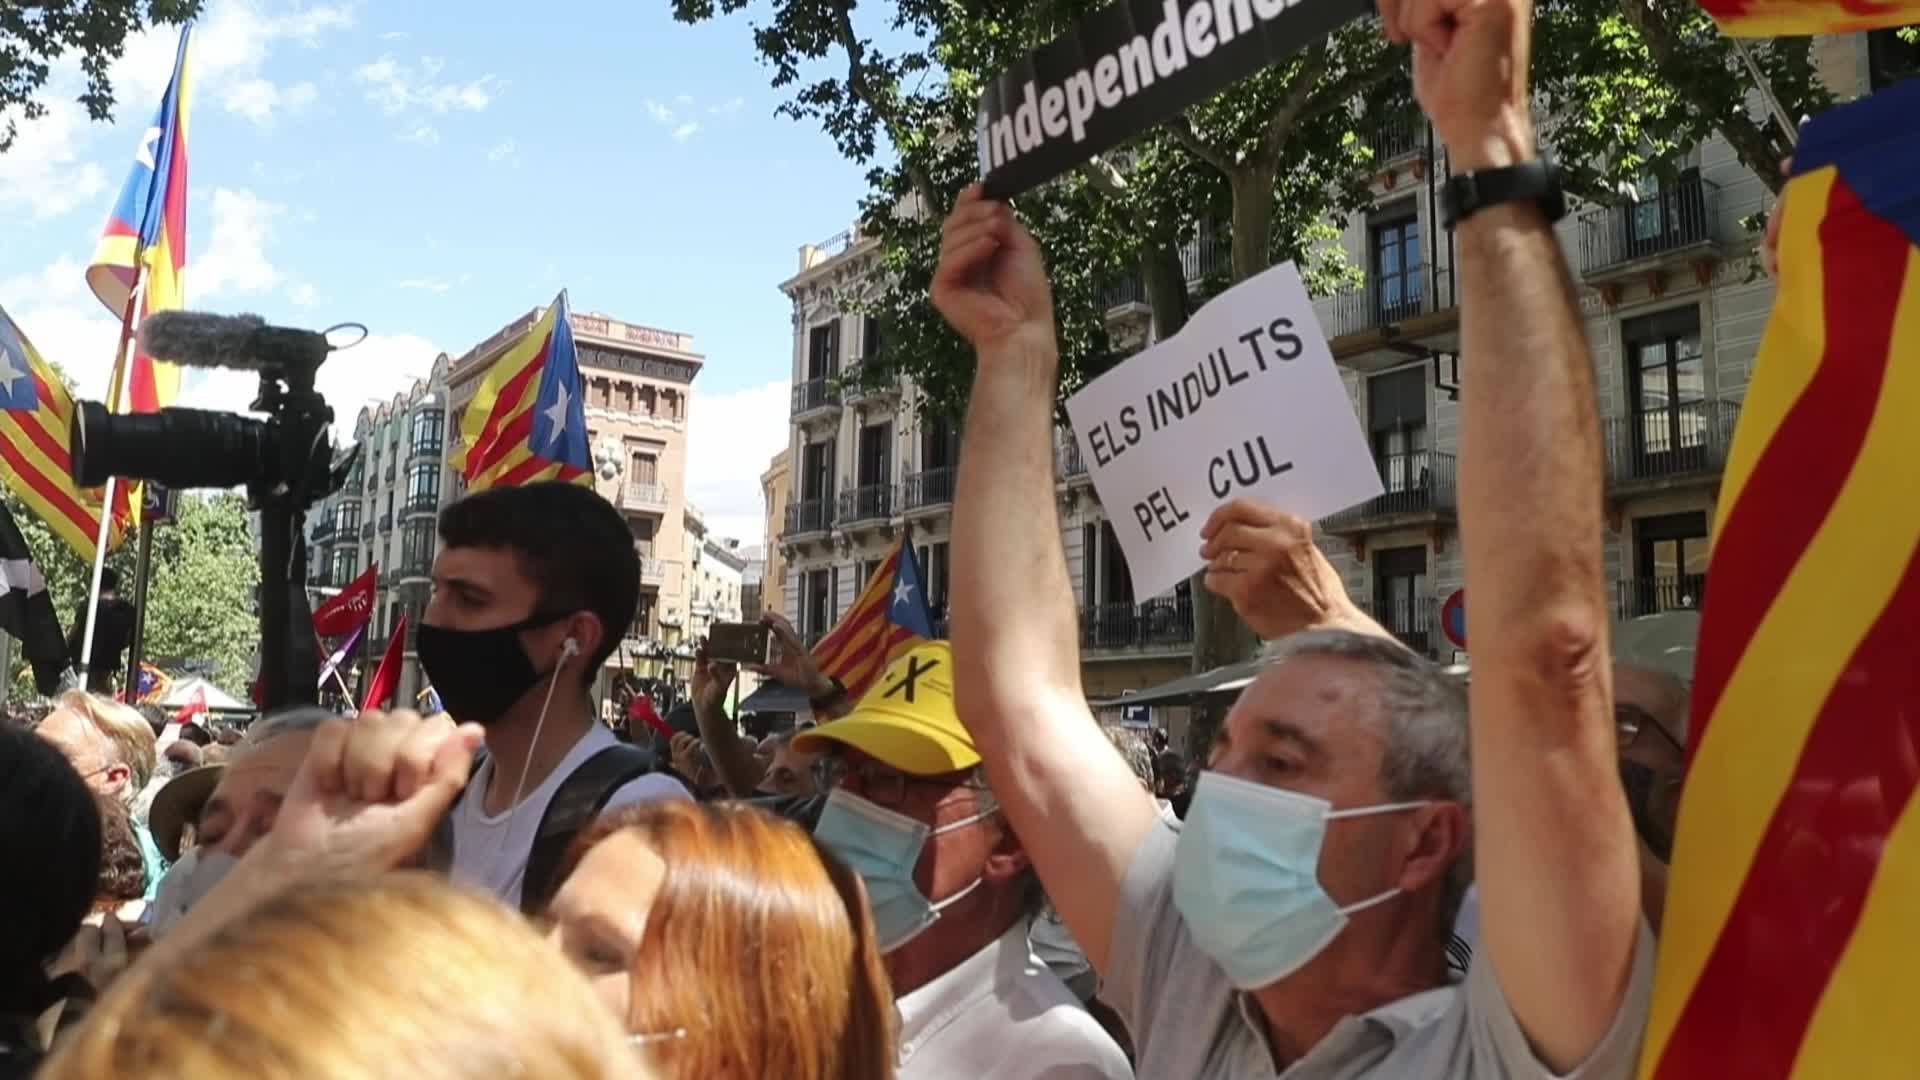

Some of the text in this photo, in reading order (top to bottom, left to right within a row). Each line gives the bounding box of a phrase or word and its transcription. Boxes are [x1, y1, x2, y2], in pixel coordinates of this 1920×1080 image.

[978, 0, 1301, 178] independen
[1087, 317, 1304, 468] ELS INDULTS
[1133, 435, 1294, 542] PEL CUL
